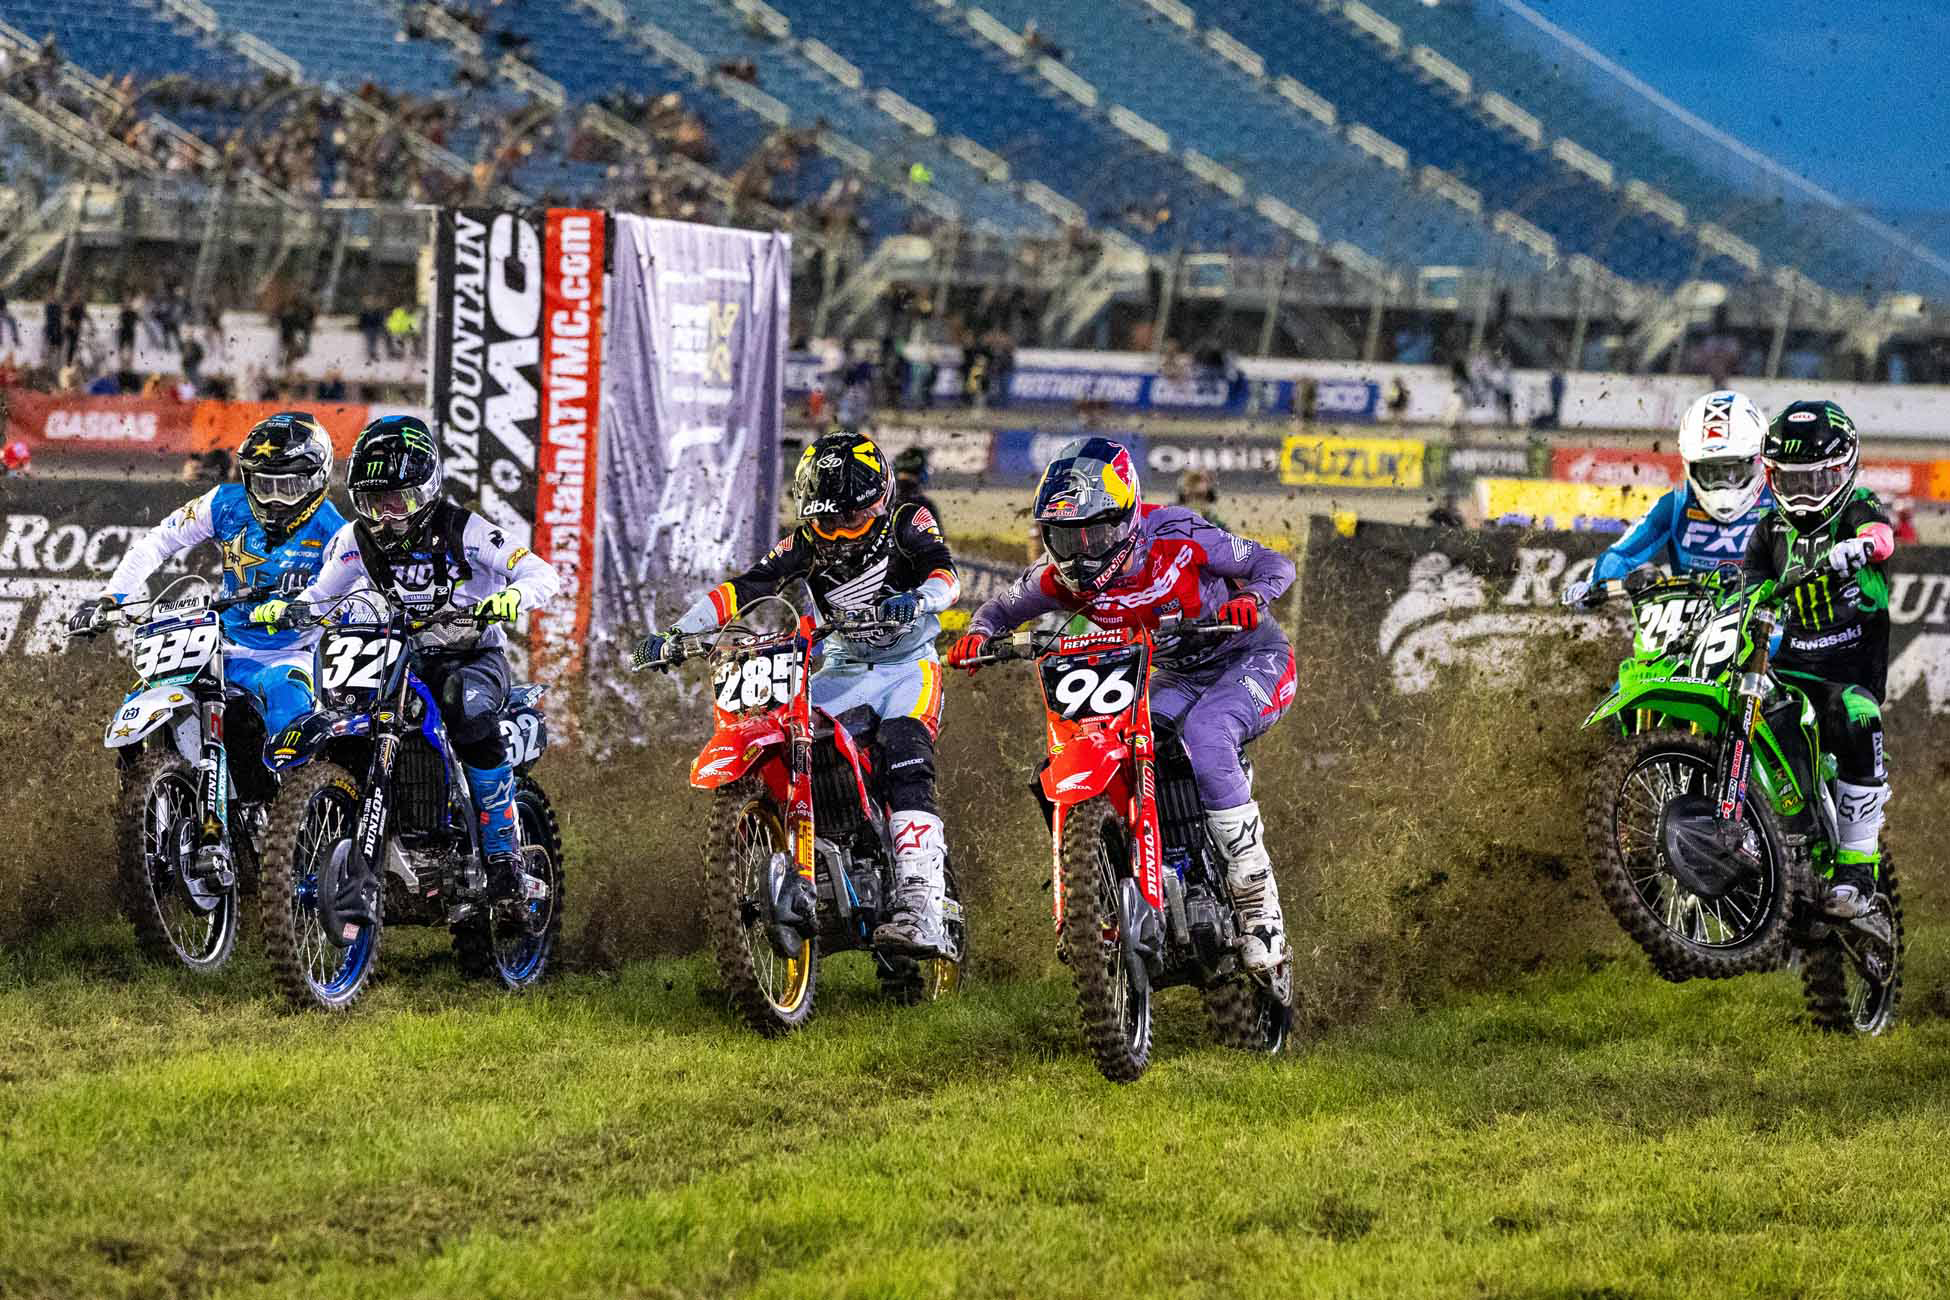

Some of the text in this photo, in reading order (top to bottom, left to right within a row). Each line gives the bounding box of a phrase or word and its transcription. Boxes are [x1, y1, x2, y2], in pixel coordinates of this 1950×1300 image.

[442, 211, 489, 491] MOUNTAIN
[134, 626, 217, 678] 339
[322, 636, 403, 689] 32
[1790, 624, 1862, 651] Kawasaki
[713, 652, 805, 713] 285
[1055, 664, 1135, 720] 96
[499, 713, 540, 768] 32
[363, 787, 384, 858] DUNLOP
